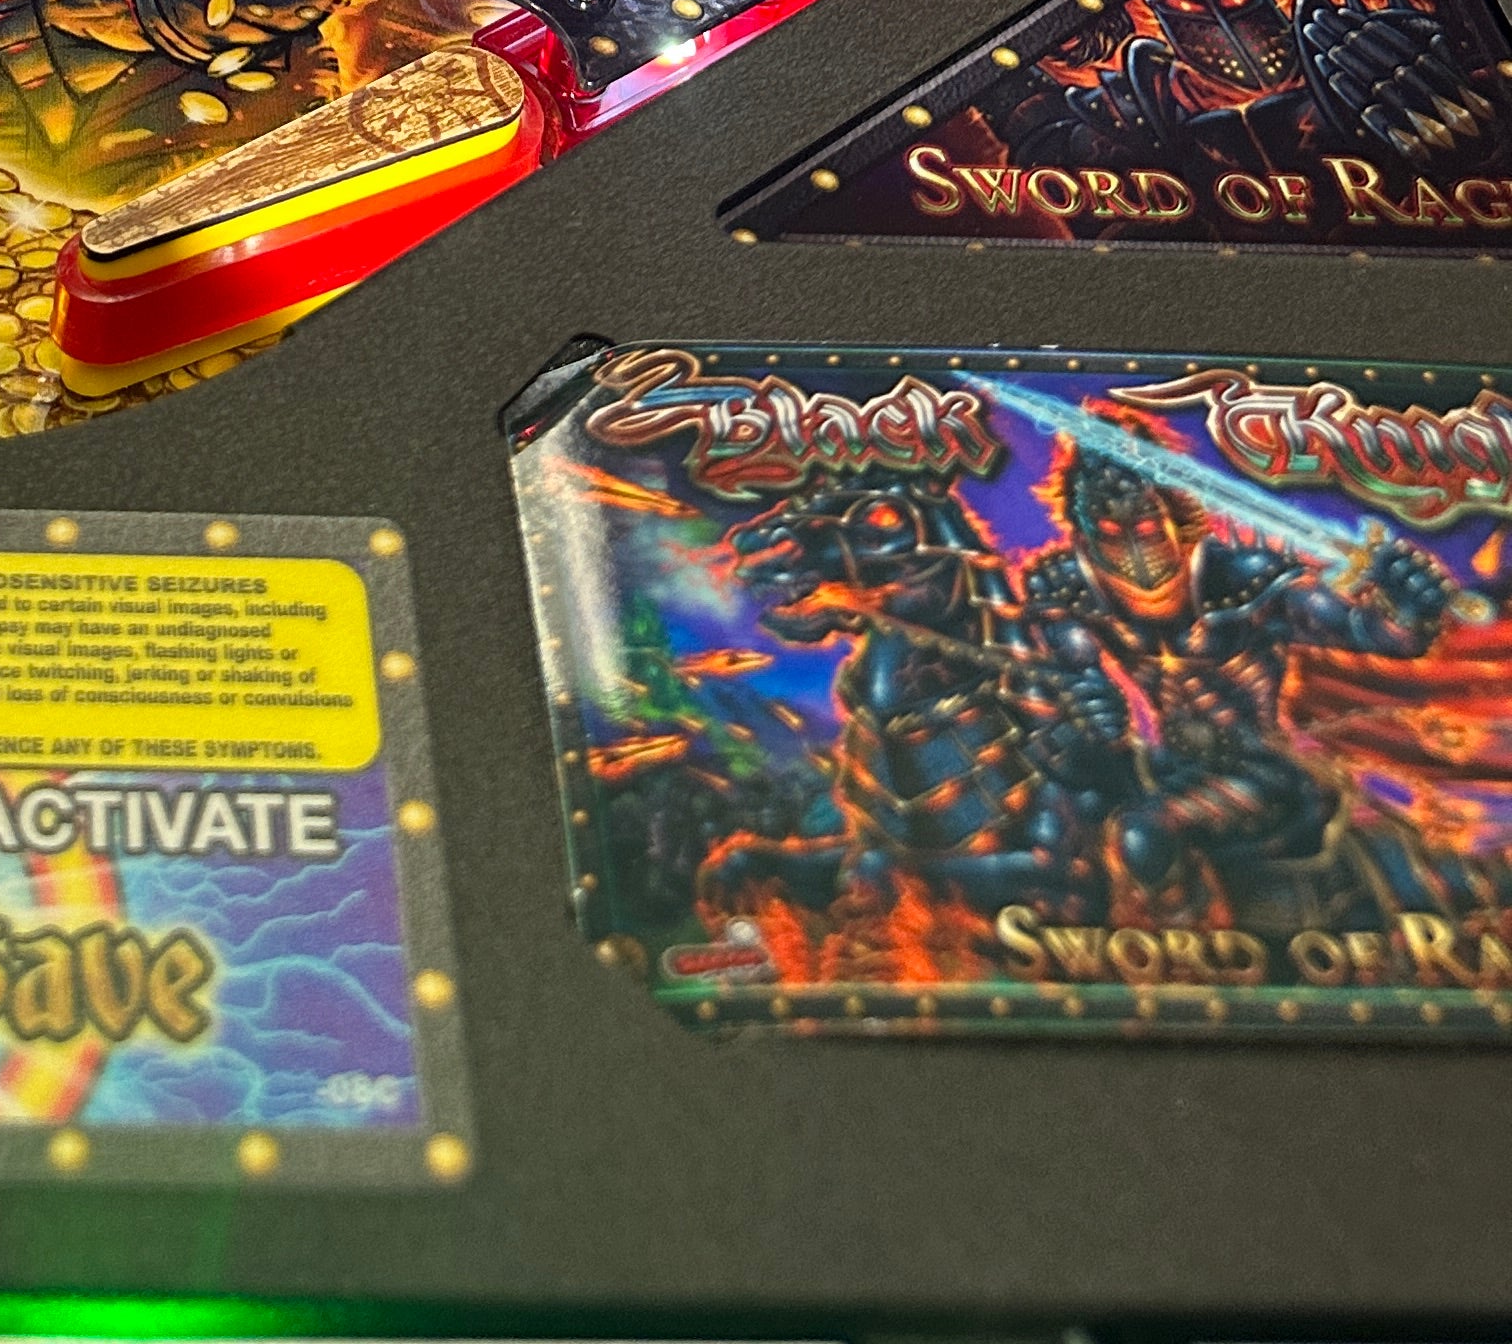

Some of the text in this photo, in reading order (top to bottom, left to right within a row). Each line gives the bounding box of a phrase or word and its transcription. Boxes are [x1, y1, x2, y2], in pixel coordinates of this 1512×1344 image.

[906, 145, 1512, 226] SWORD OF RAG
[146, 575, 268, 596] SEIZURES
[13, 596, 33, 612] to
[37, 597, 105, 613] certain
[109, 598, 162, 614] visual
[167, 599, 240, 620] images,
[244, 601, 331, 622] including
[34, 624, 74, 640] may
[77, 621, 123, 637] have
[126, 626, 151, 637] an
[155, 622, 273, 644] undiagnosed
[51, 735, 91, 757] ANY
[99, 736, 127, 758] OF
[132, 737, 199, 759] THESE
[203, 738, 324, 762] SYMPTOMS.
[996, 904, 1270, 987] SWORD
[1288, 927, 1388, 986] OF
